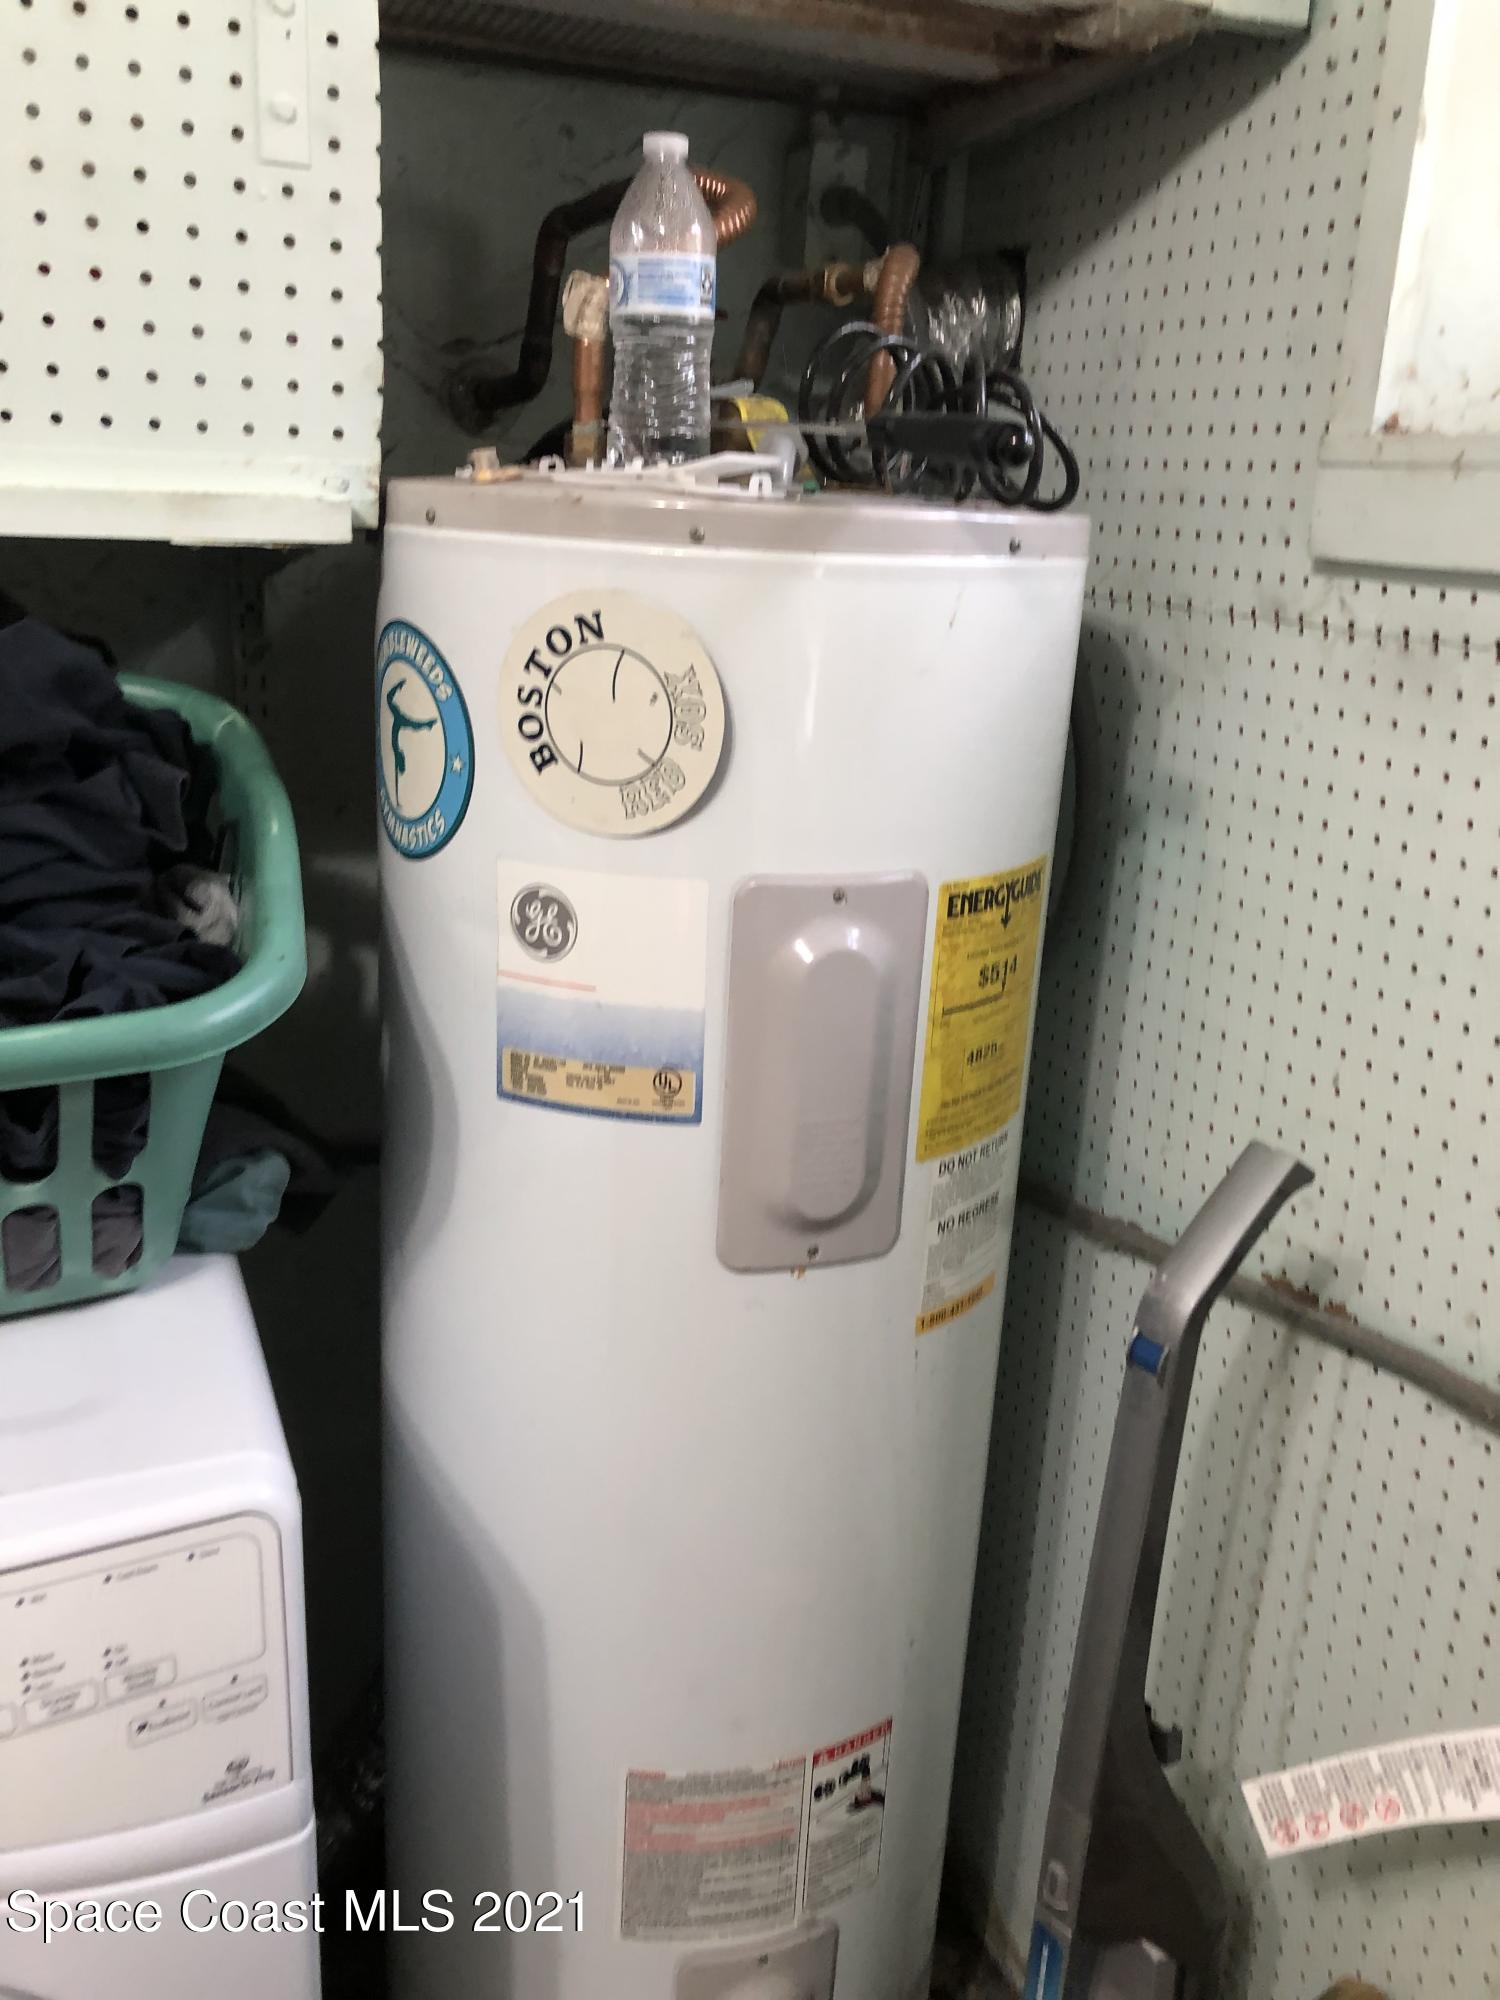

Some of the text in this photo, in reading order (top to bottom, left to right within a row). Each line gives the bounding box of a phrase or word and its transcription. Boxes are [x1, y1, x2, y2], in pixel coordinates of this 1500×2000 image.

[517, 608, 605, 776] BOSTON
[619, 662, 707, 820] RED SOX
[938, 1155, 956, 1177] DO
[958, 1146, 977, 1170] NOT
[937, 1215, 955, 1235] NO
